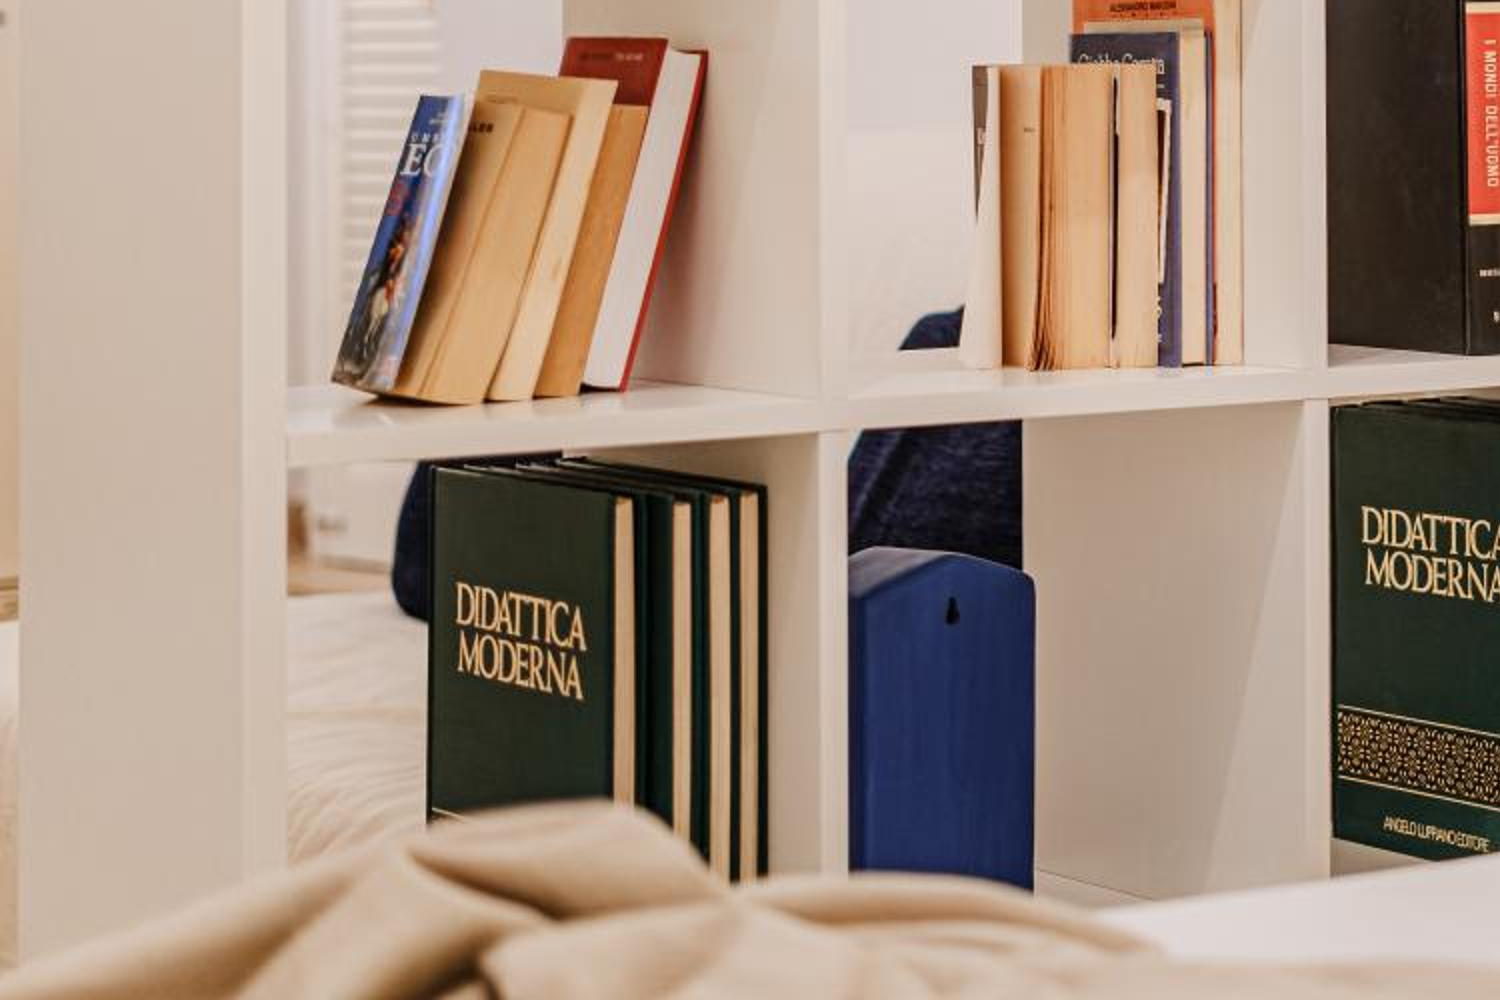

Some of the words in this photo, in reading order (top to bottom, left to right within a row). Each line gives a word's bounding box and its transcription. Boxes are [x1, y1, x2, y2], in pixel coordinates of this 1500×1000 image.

[1484, 50, 1497, 98] MONDI
[1485, 105, 1499, 187] DELL'UOMO
[456, 581, 587, 651] DIDATTICA
[457, 630, 584, 700] MODERNA
[1383, 815, 1417, 837] ANGELO
[1456, 831, 1490, 853] EDITORE
